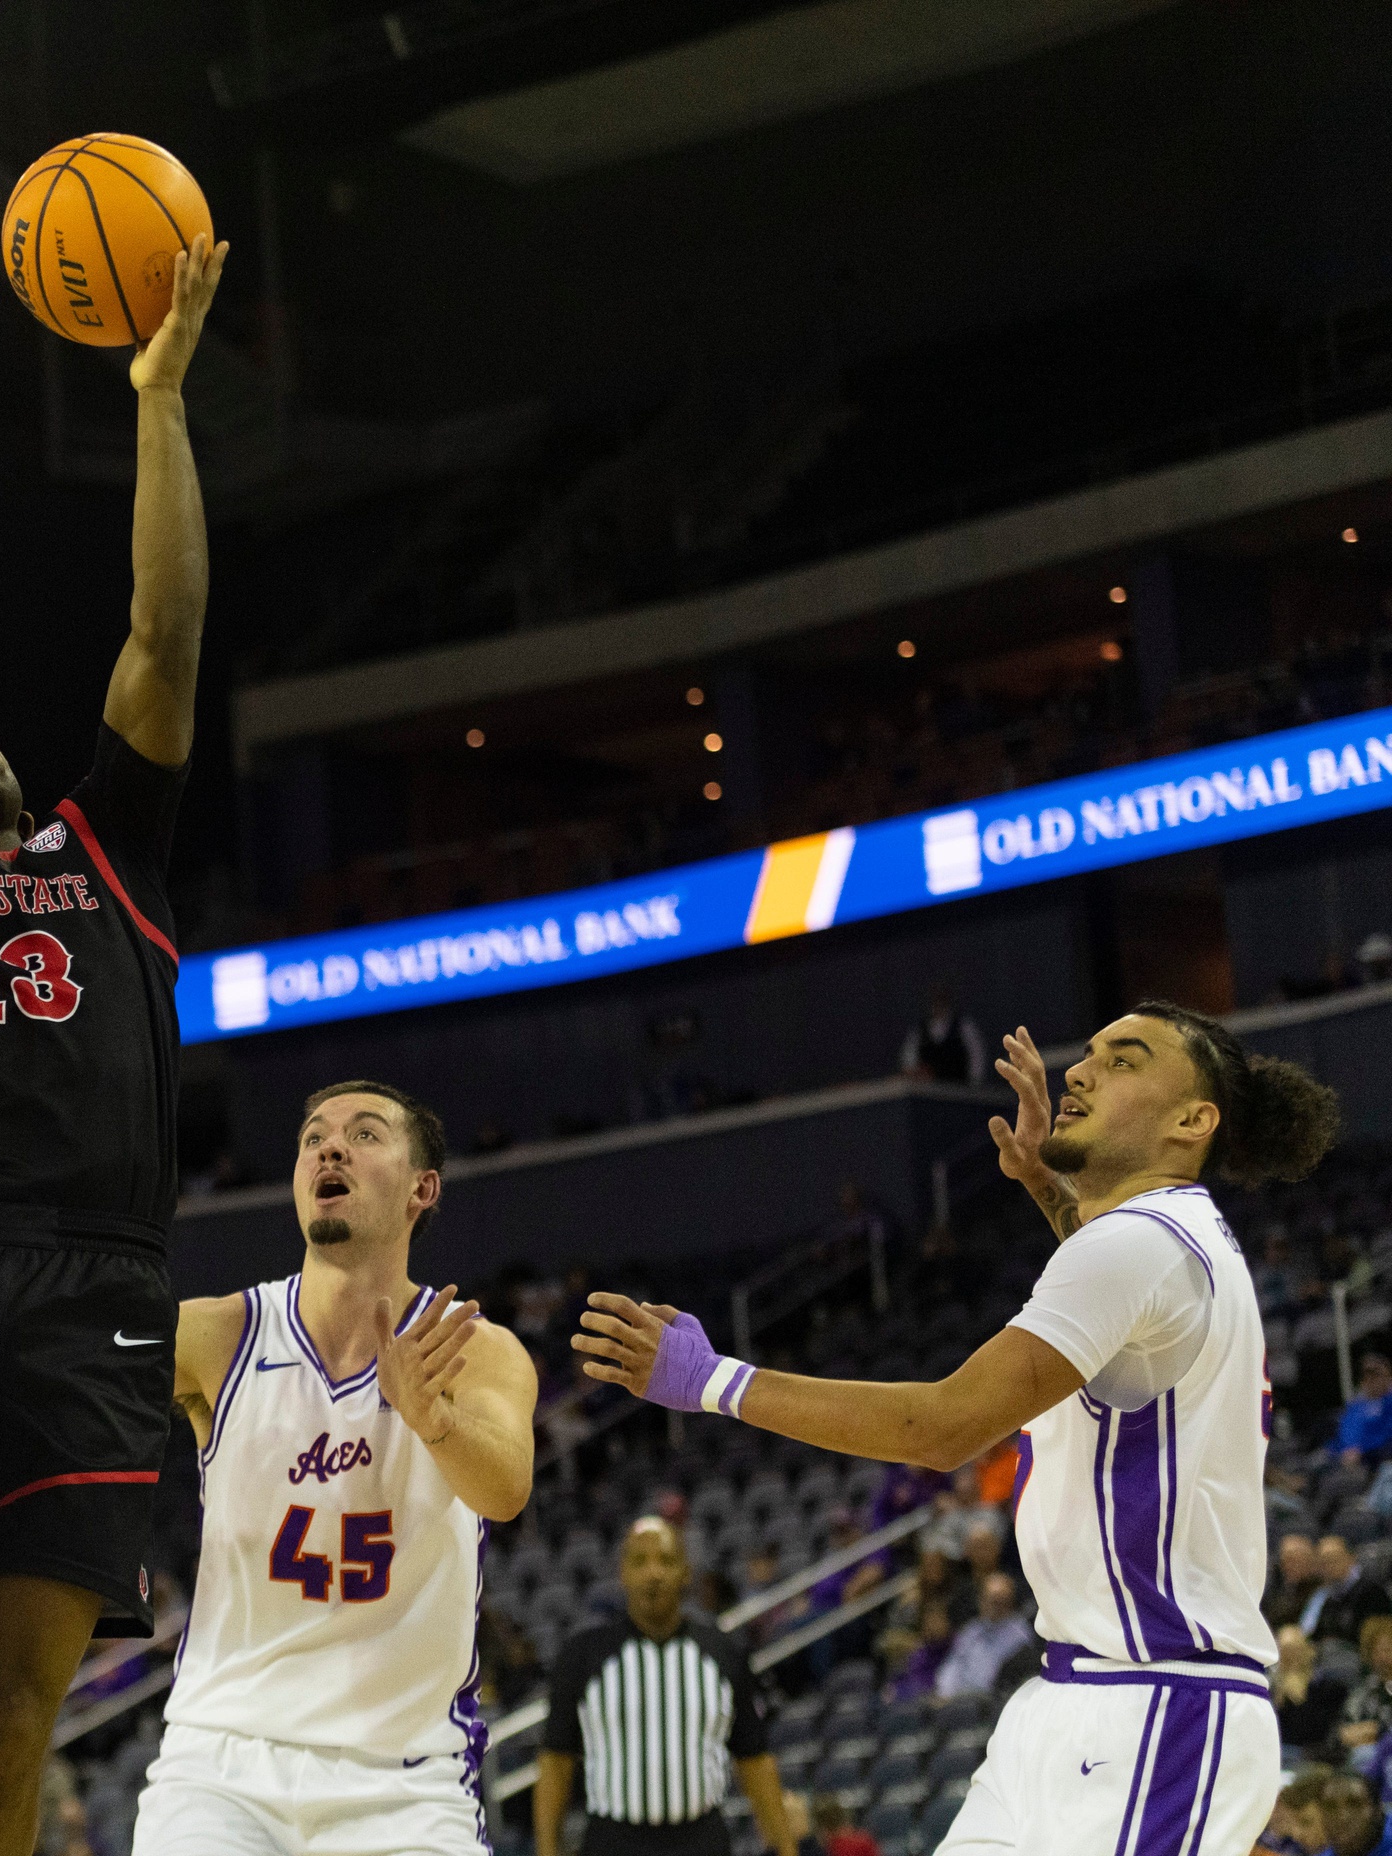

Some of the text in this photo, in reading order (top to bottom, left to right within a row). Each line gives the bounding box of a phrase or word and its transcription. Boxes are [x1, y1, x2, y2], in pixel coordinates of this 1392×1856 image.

[983, 733, 1392, 865] OLD NATIONAL BAN
[268, 894, 681, 1005] OLD NATIONAL BANK
[288, 1431, 373, 1486] Aces
[269, 1504, 396, 1603] 45
